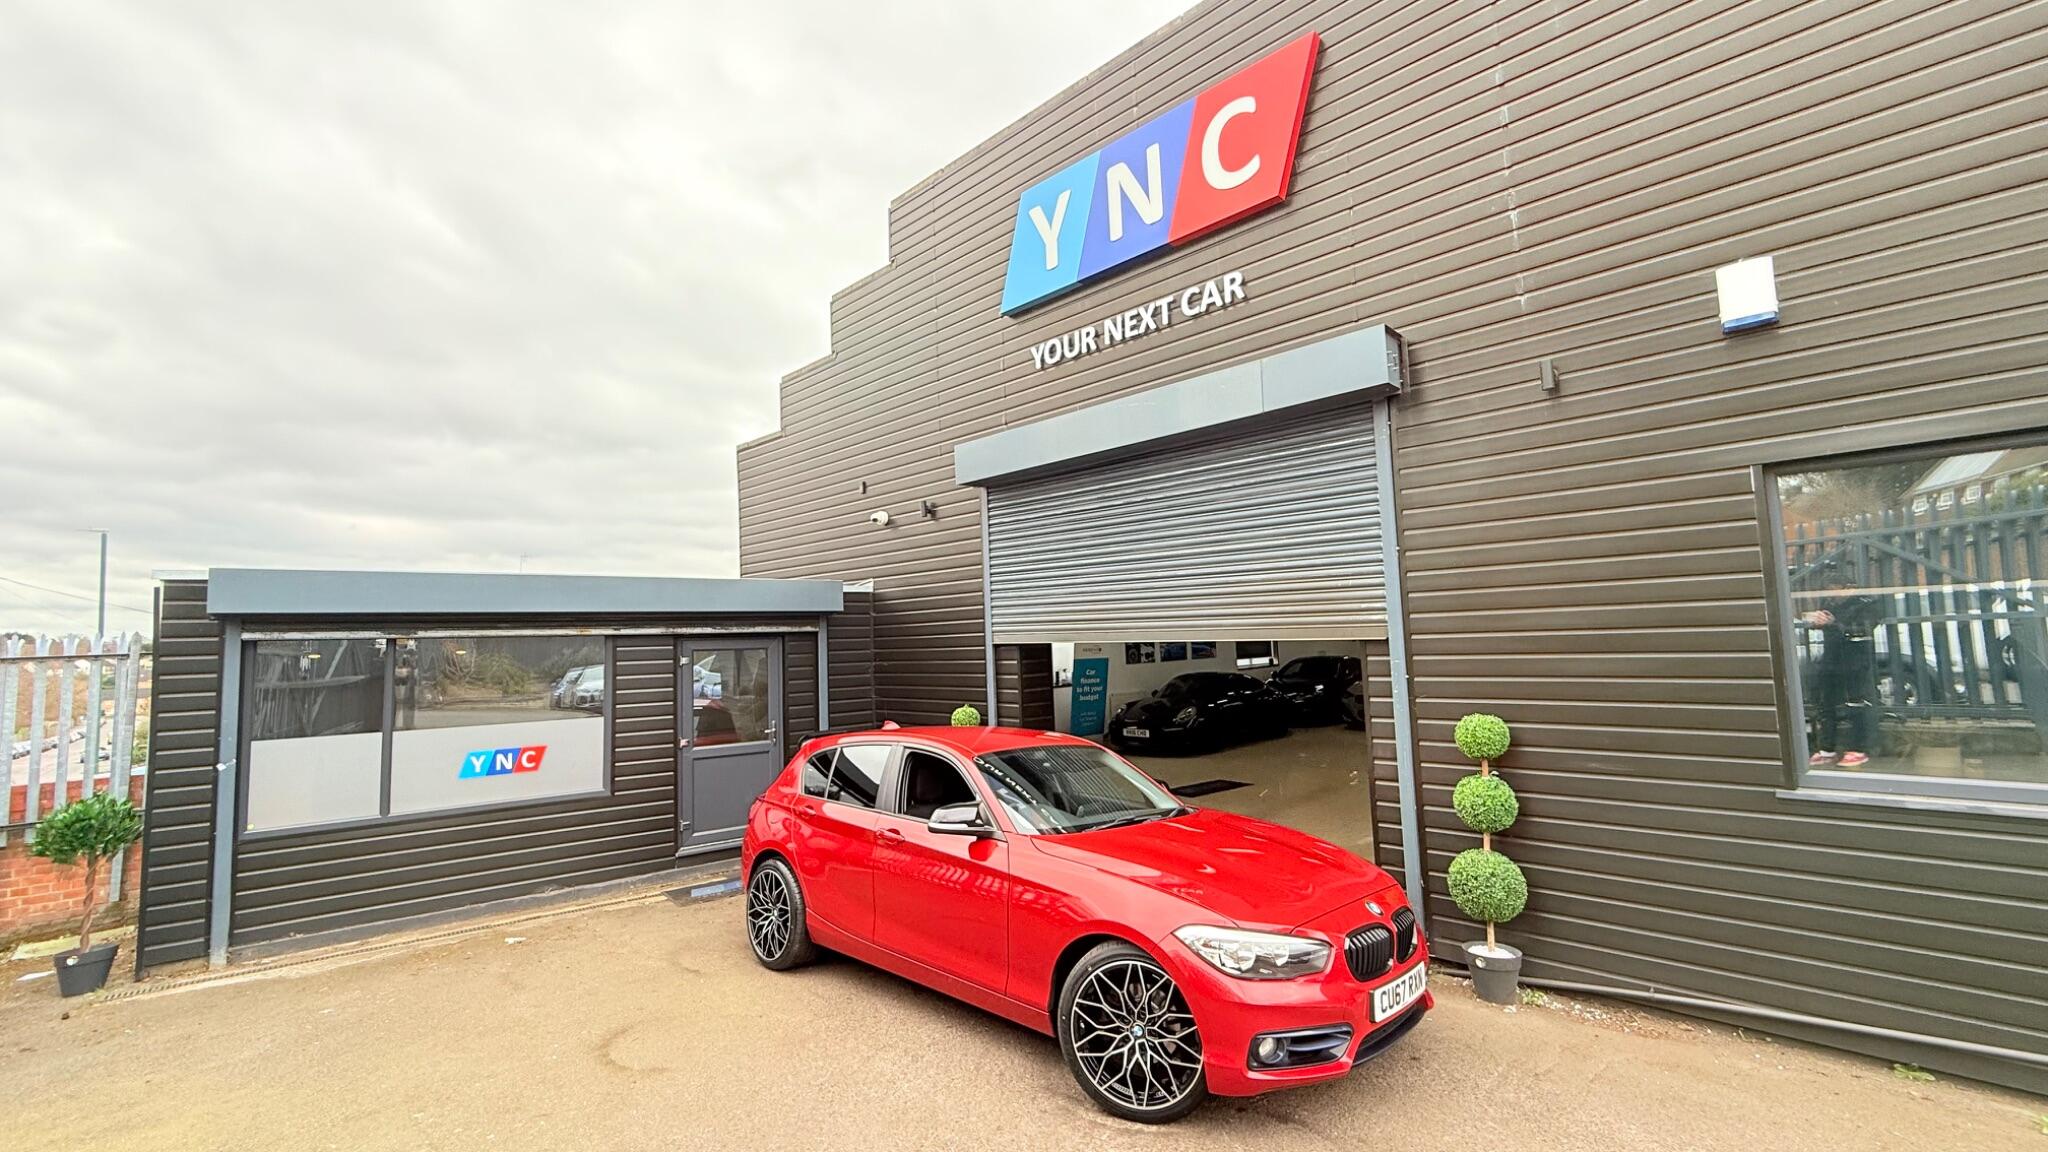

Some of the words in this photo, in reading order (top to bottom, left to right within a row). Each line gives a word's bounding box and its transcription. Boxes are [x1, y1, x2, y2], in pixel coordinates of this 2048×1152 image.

[1028, 95, 1261, 270] YNC
[1030, 325, 1097, 370] YOUR
[1104, 295, 1174, 344] NEXT
[1180, 271, 1247, 317] CAR
[1080, 677, 1100, 685] finance
[1091, 685, 1103, 693] your
[470, 751, 536, 773] YNC
[1380, 979, 1406, 1013] CU67
[1408, 967, 1423, 997] RXN
